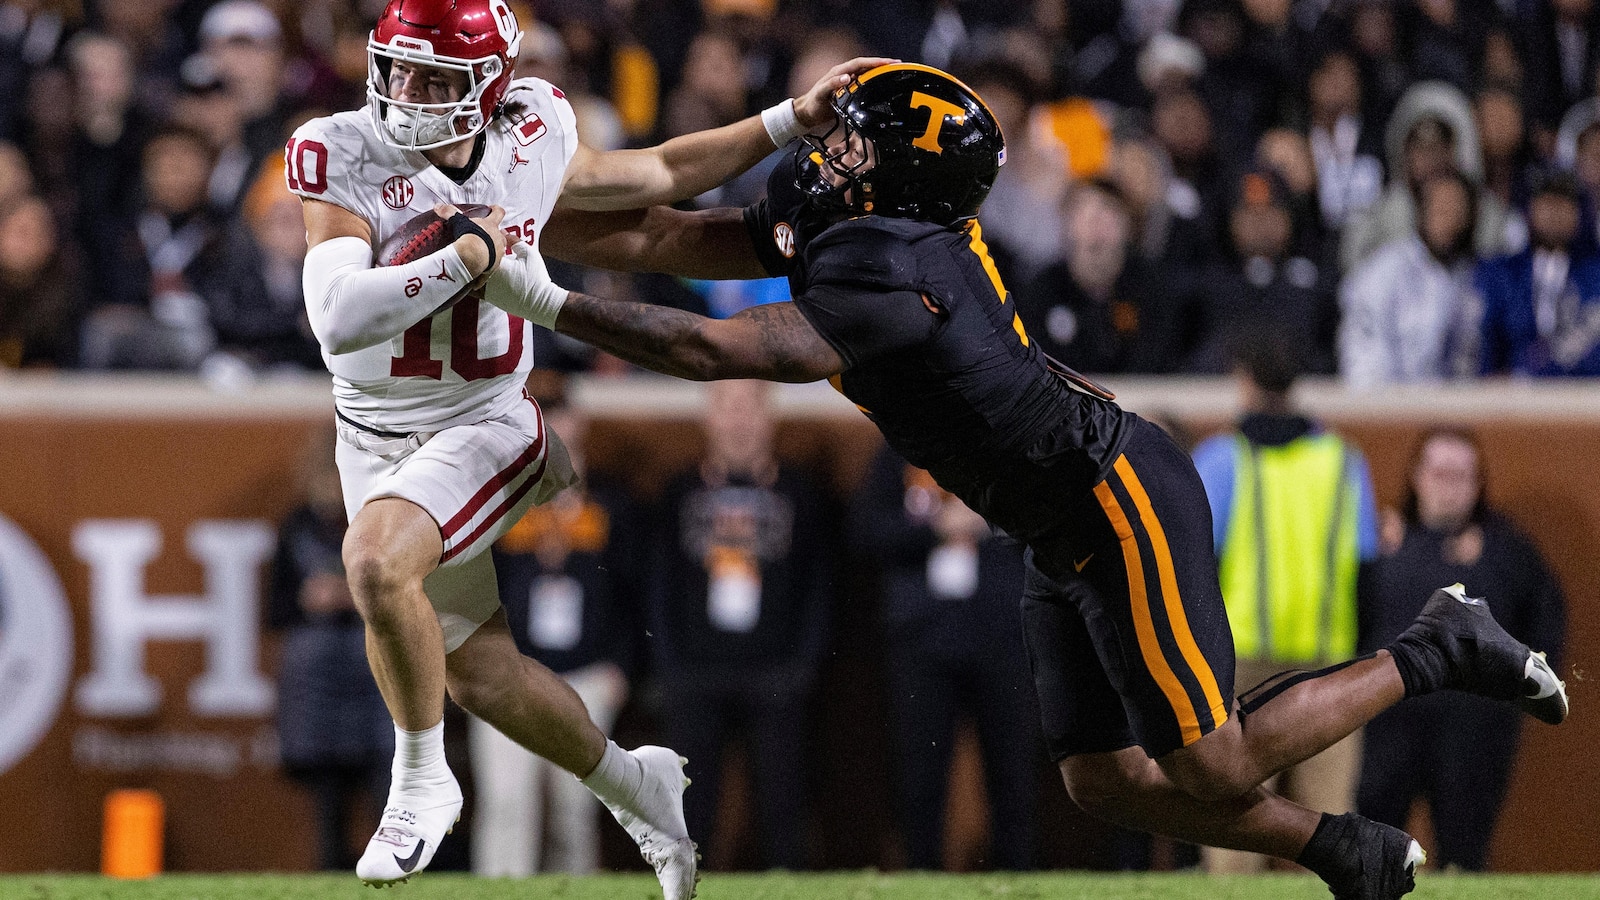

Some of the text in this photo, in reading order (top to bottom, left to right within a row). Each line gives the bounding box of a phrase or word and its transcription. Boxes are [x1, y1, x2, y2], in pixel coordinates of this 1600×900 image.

[910, 91, 965, 156] T
[285, 137, 328, 195] 10
[382, 176, 414, 209] SEC
[390, 299, 525, 382] 10
